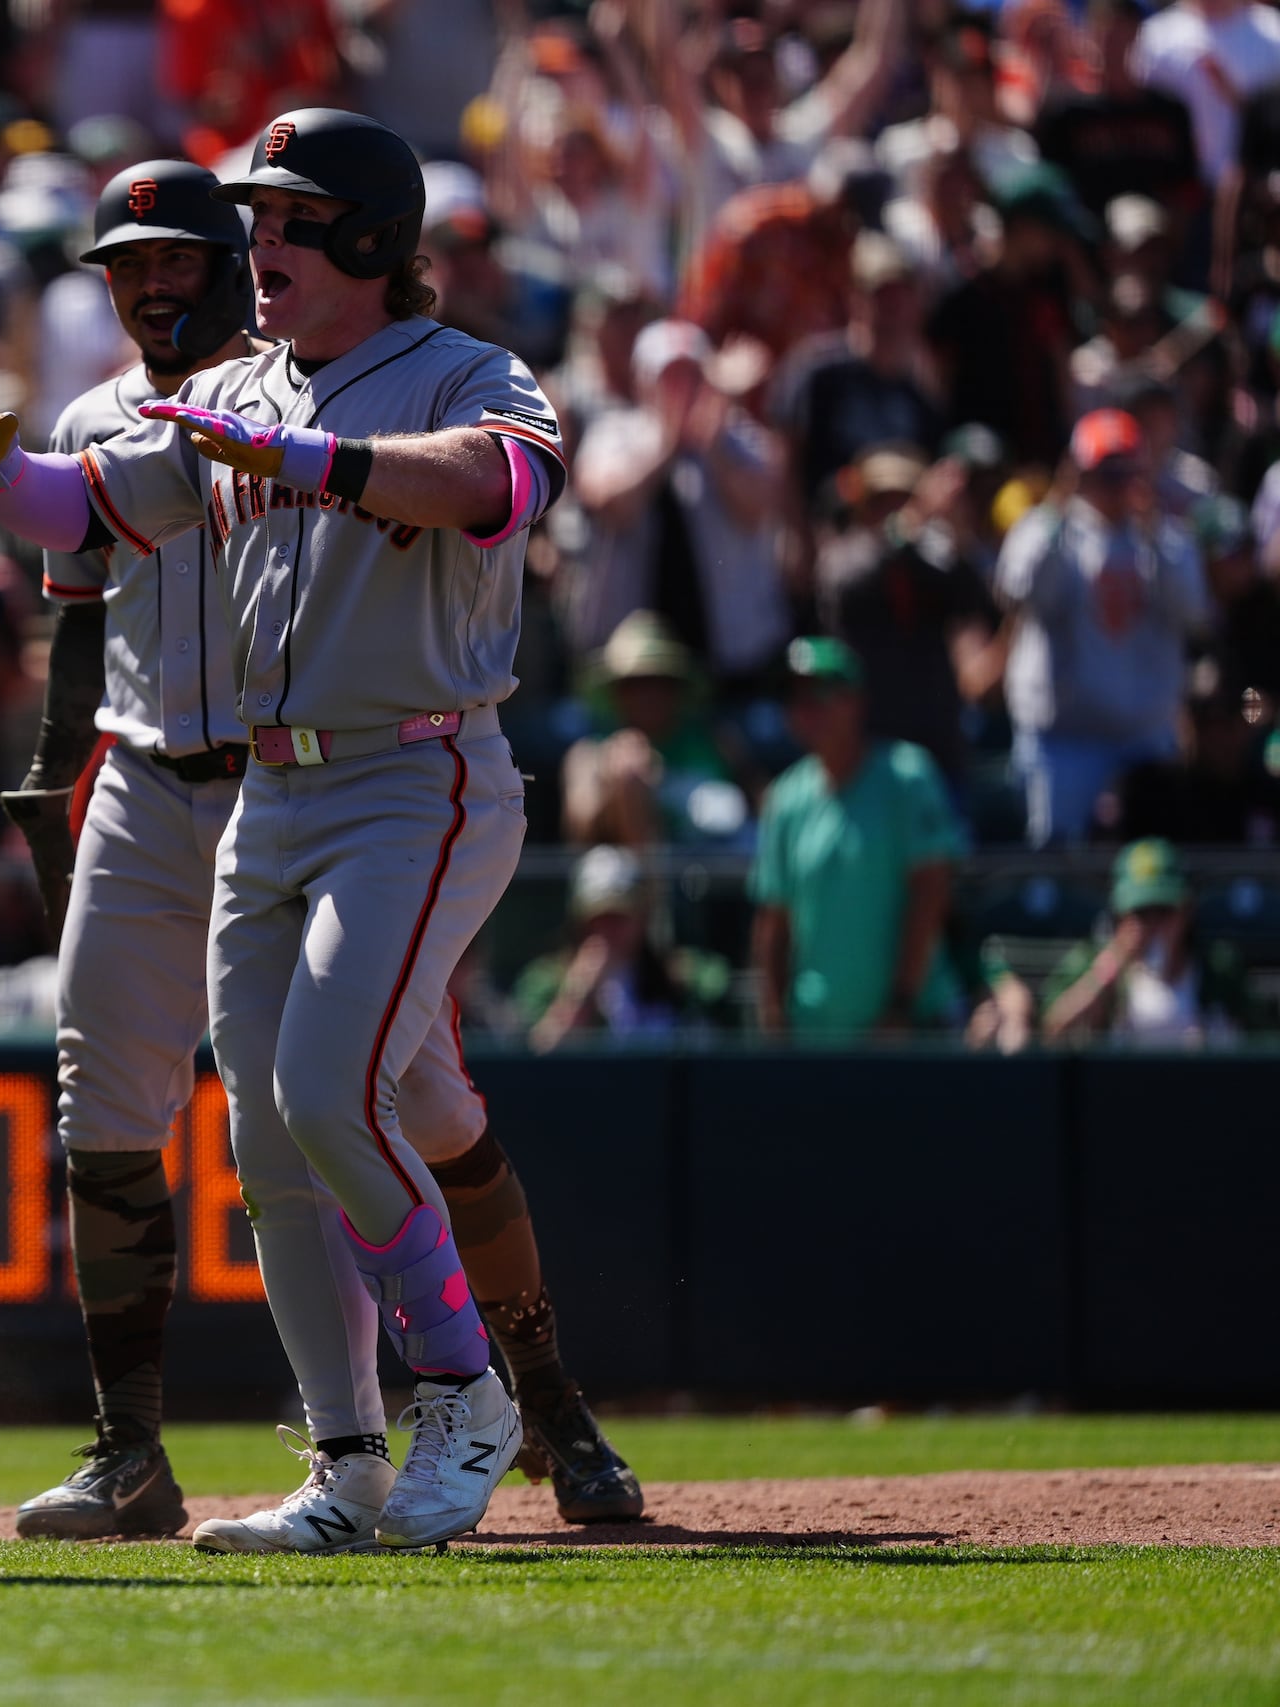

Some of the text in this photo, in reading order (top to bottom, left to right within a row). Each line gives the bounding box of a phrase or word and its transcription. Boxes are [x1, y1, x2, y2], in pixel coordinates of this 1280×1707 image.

[265, 121, 296, 160] SF
[129, 177, 158, 219] SF
[299, 731, 311, 753] 9
[225, 753, 237, 773] 2
